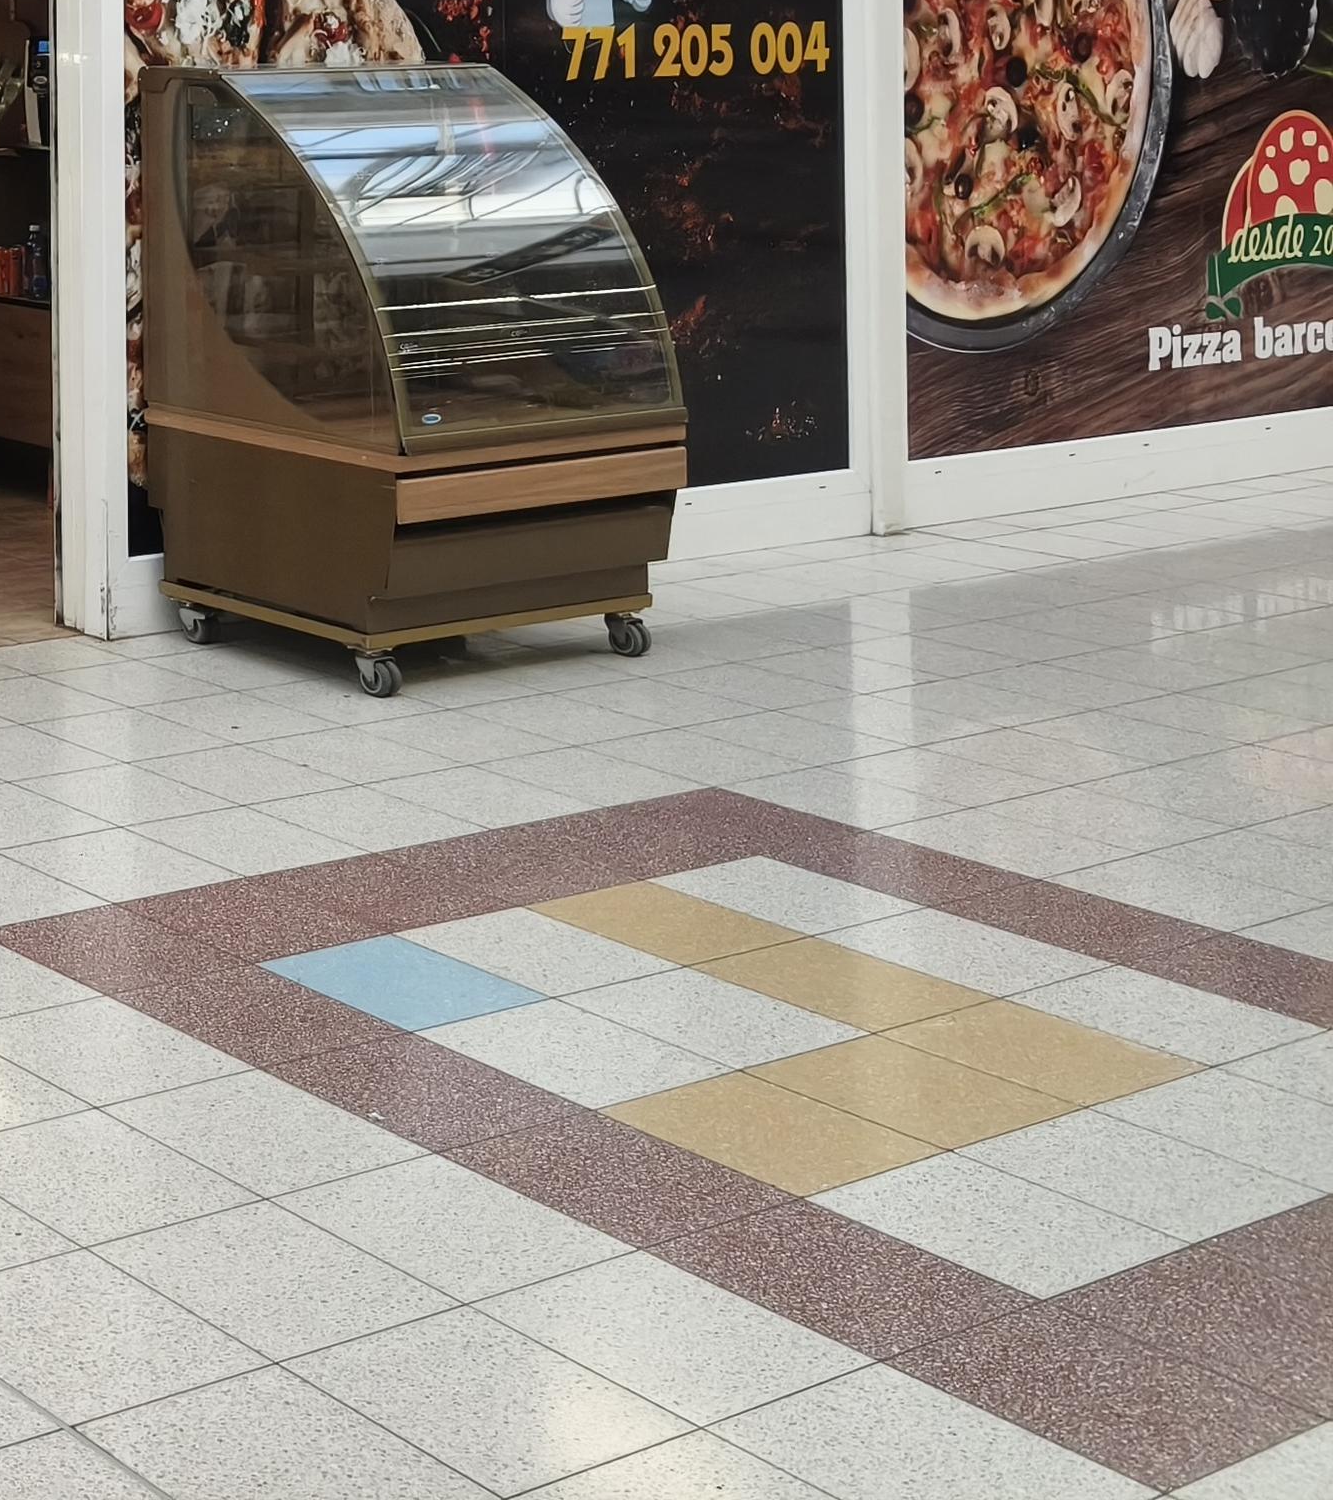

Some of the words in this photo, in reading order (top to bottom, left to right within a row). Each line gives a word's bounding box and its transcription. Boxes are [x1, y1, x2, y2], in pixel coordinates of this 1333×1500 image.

[561, 23, 636, 81] 771
[653, 22, 733, 78] 205
[750, 21, 830, 75] 004
[1227, 214, 1304, 264] desde
[1148, 324, 1242, 371] Pizza
